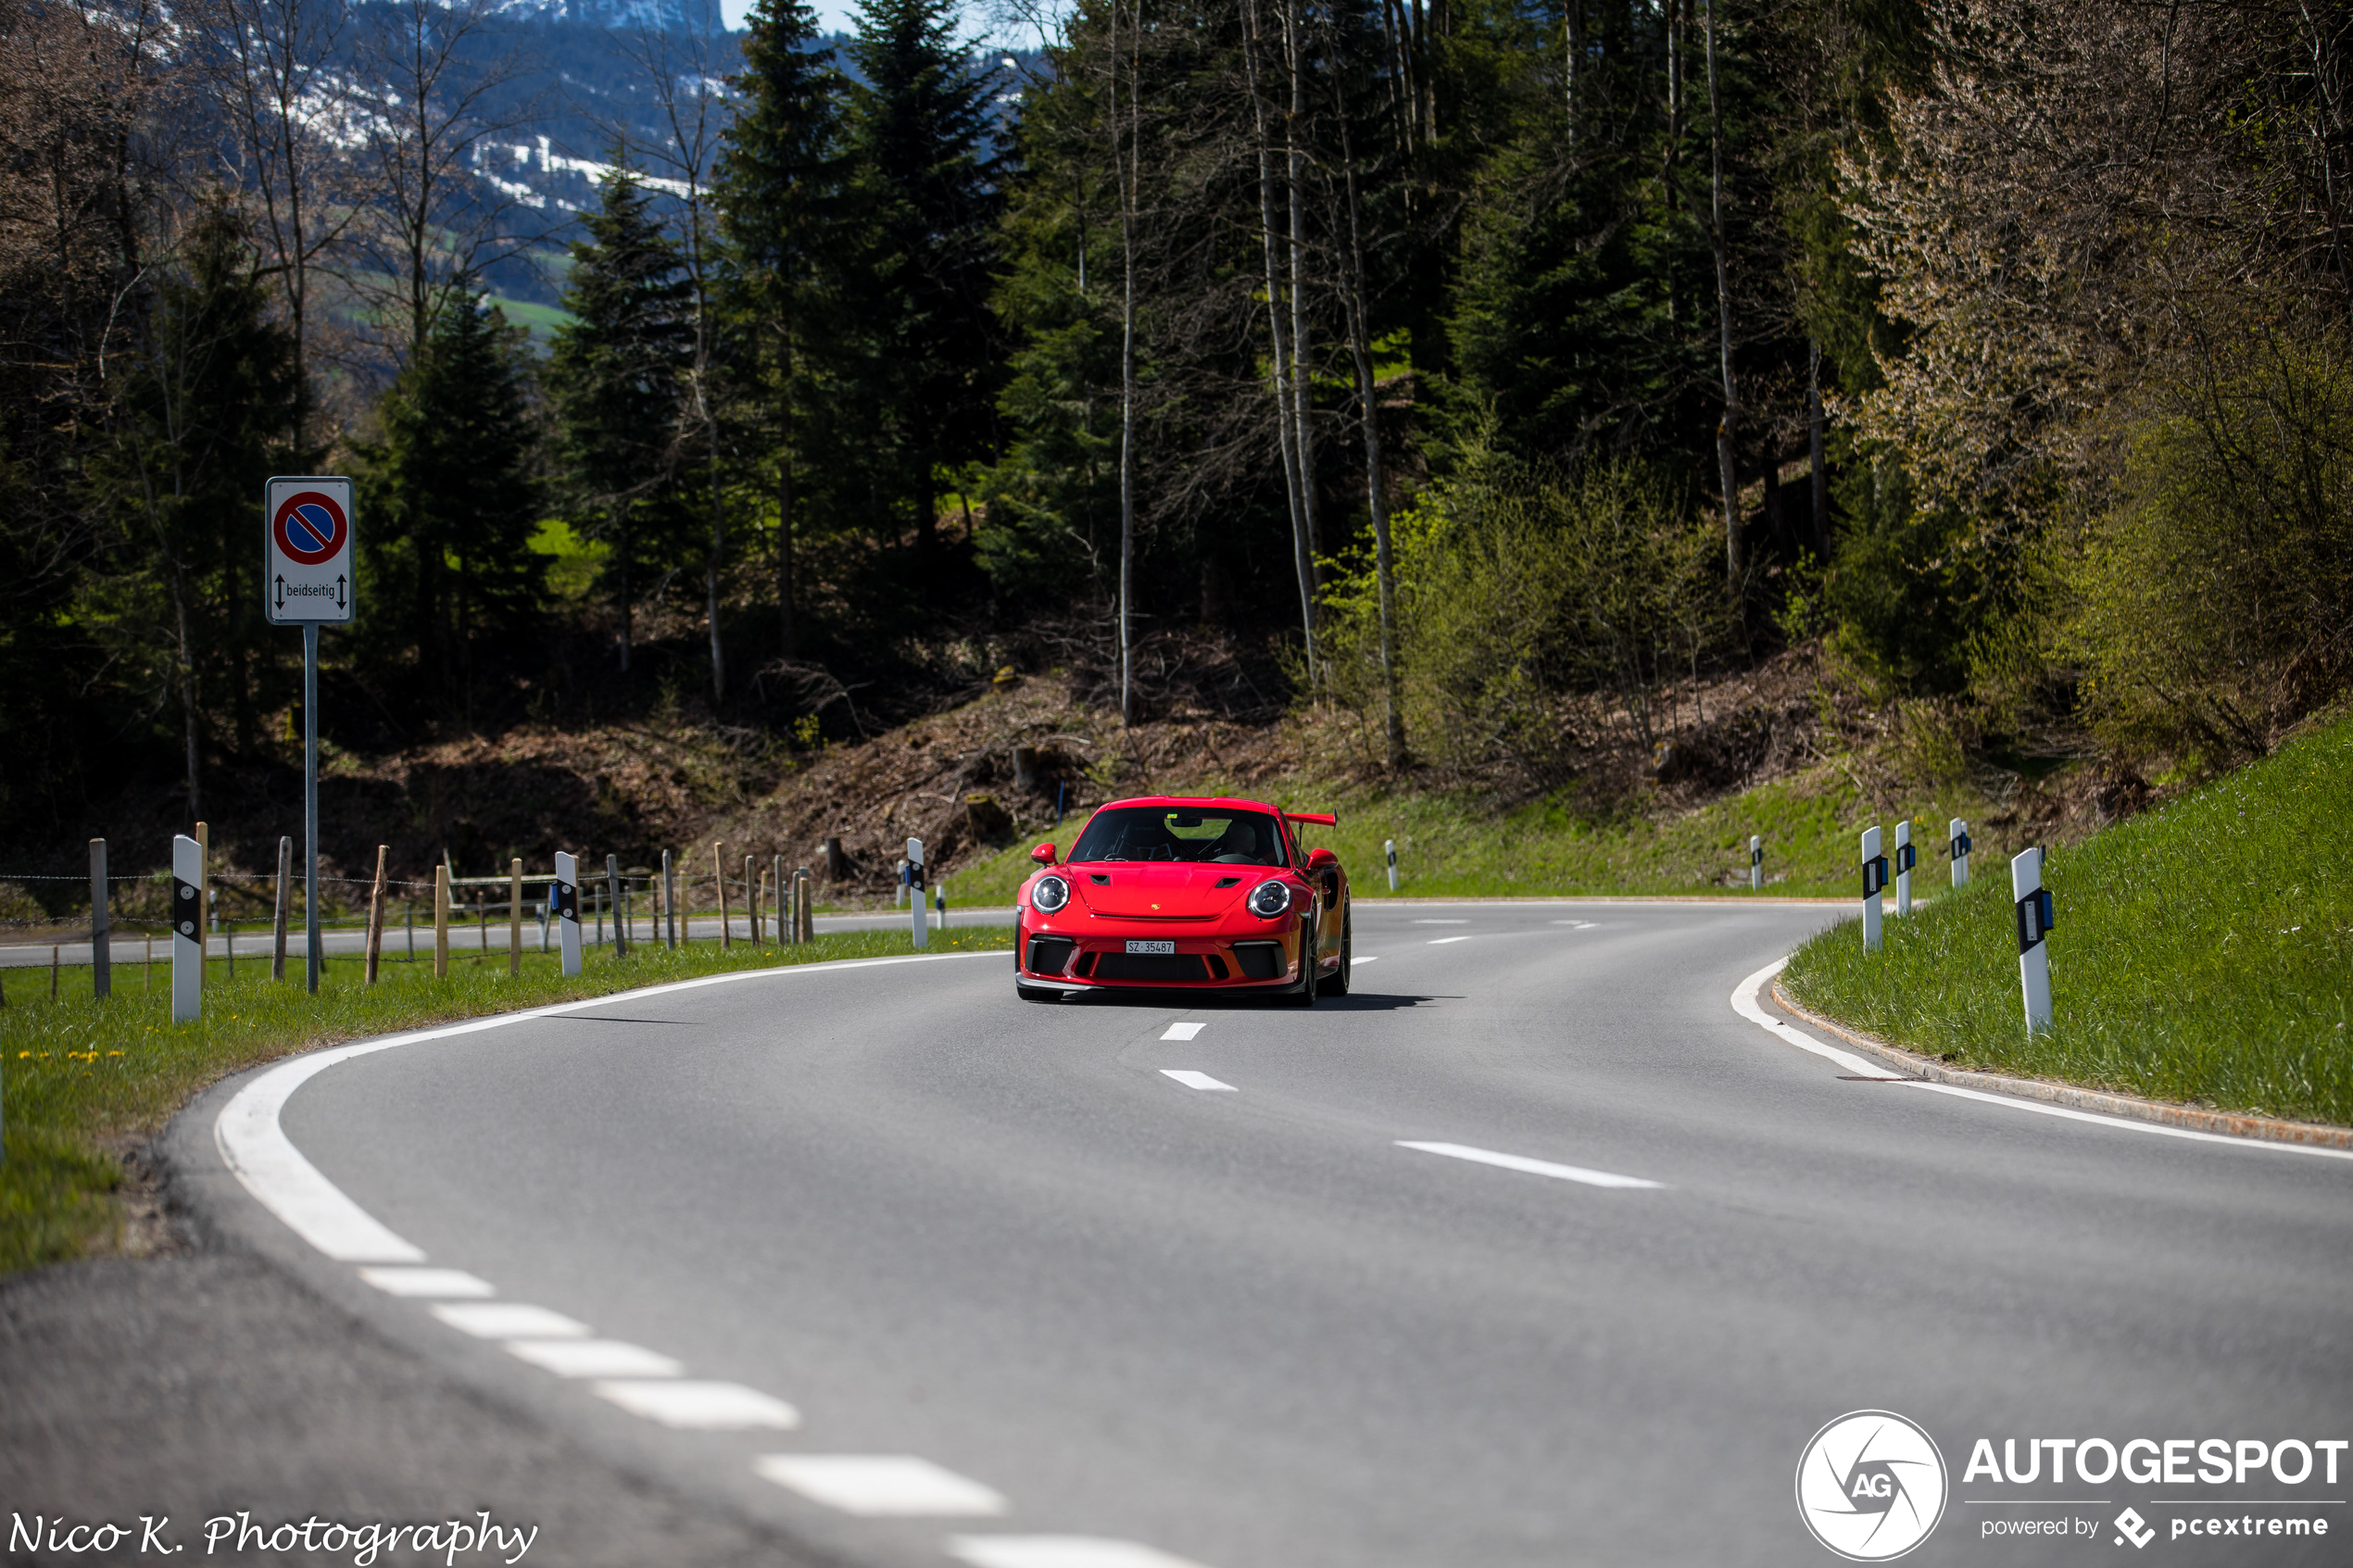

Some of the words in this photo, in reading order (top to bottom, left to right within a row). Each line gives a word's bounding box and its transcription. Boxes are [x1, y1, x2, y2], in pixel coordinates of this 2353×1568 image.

[286, 583, 335, 600] beidseitig
[1128, 942, 1139, 952] SZ
[1145, 942, 1172, 952] 35487
